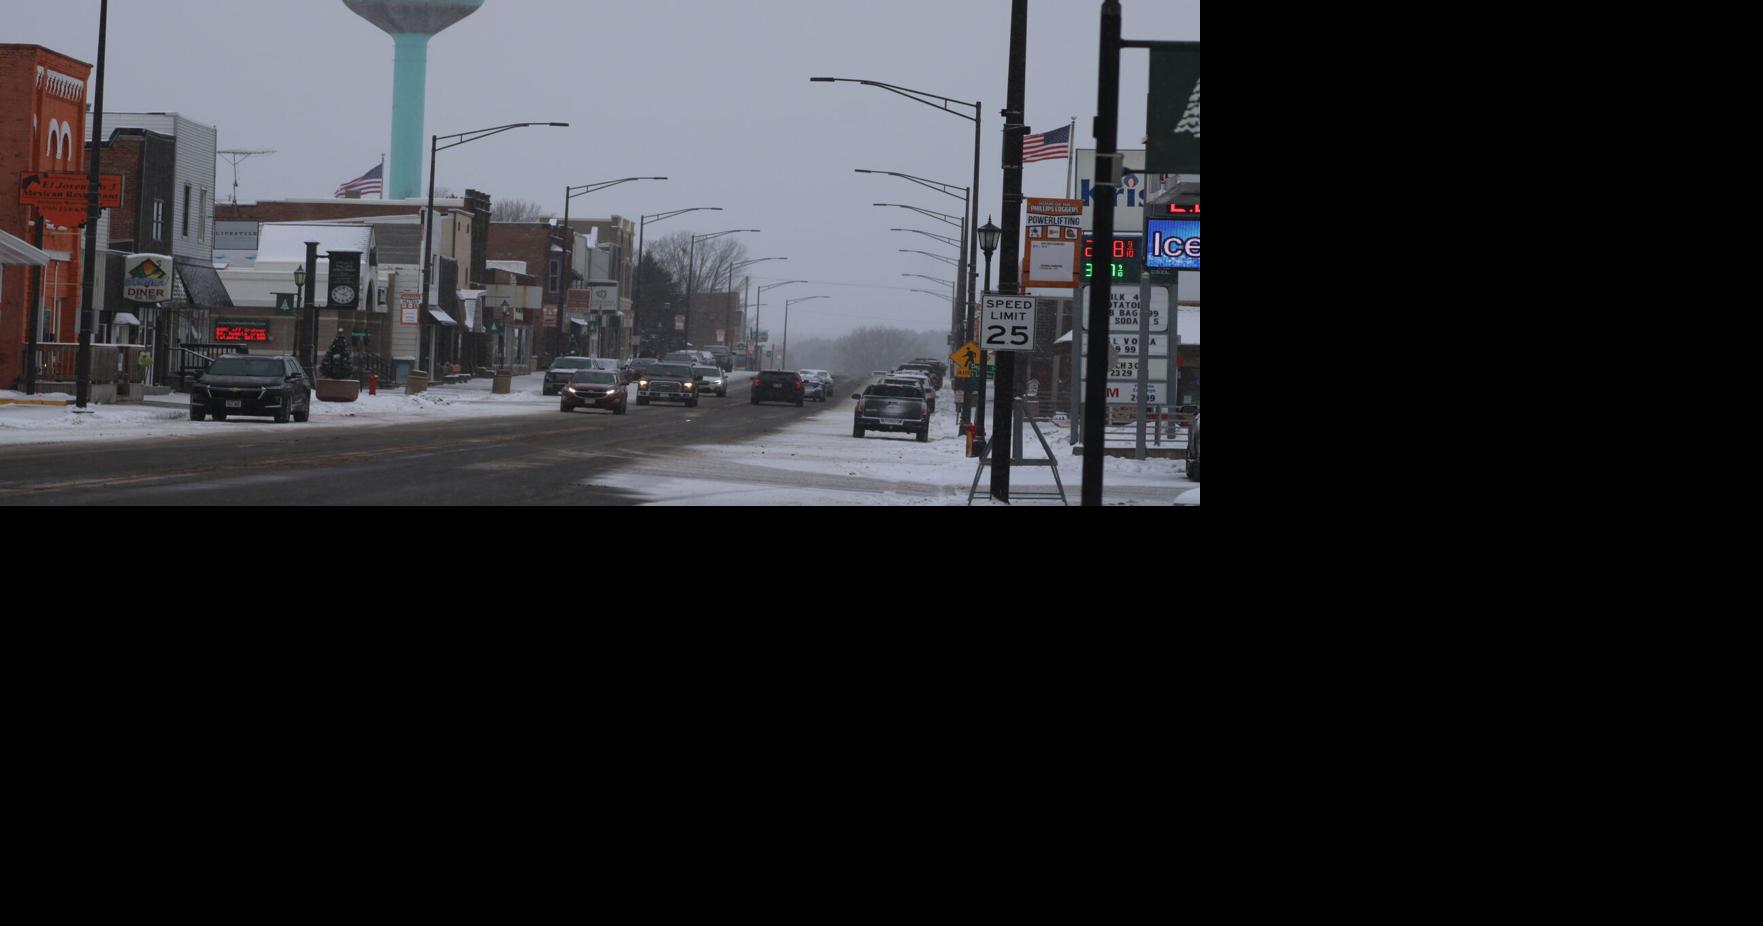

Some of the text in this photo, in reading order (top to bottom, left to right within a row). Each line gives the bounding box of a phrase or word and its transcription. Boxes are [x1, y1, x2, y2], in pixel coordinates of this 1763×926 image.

[23, 190, 64, 198] Mexican
[1028, 215, 1080, 226] POWERLIFTING
[1153, 231, 1200, 257] Ice
[127, 287, 165, 297] DINER
[986, 299, 1032, 309] SPEED
[991, 311, 1027, 321] LIMIT
[1119, 309, 1138, 317] BAG
[1115, 317, 1138, 325] SODA
[986, 324, 1029, 345] 25
[1123, 337, 1156, 345] VOA
